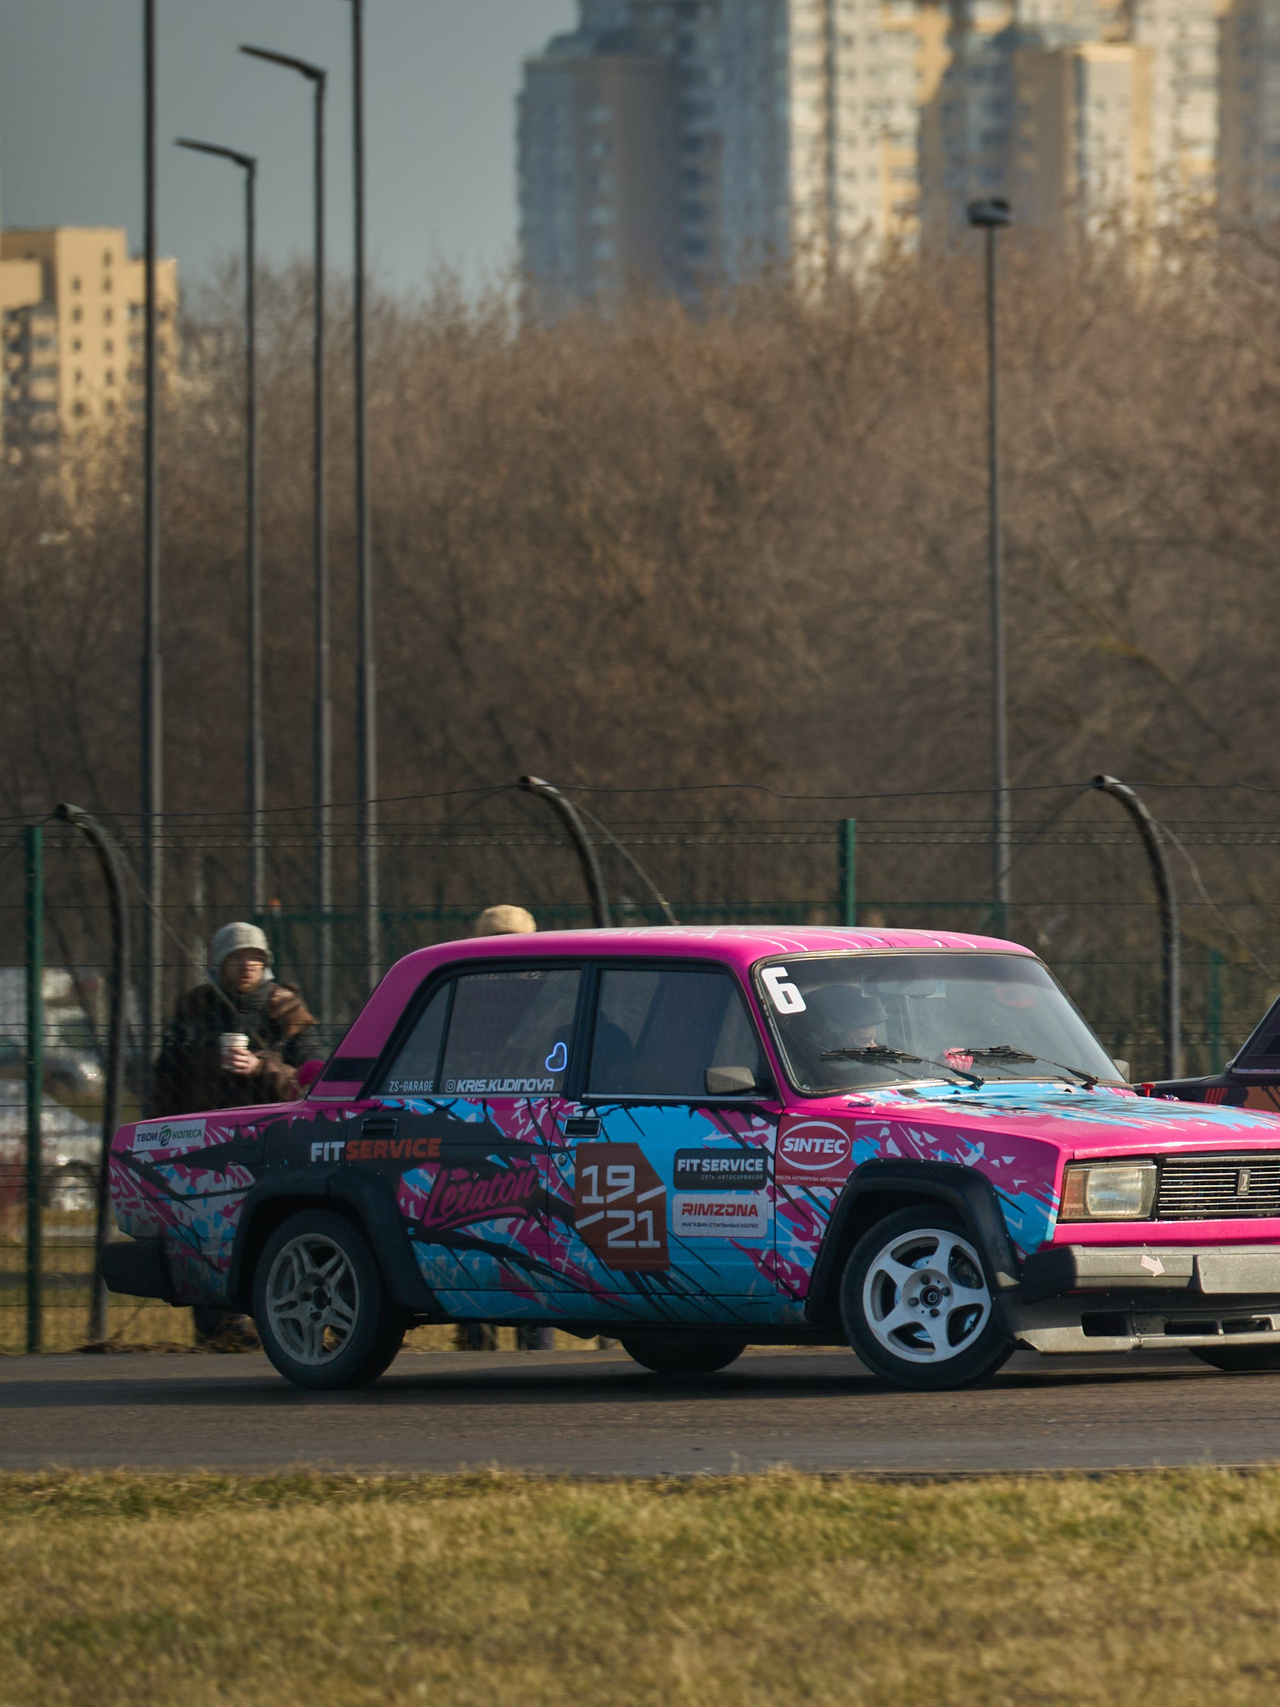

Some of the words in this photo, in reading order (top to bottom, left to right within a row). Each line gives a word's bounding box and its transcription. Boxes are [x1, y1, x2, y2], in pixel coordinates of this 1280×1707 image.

[761, 966, 807, 1015] 6
[389, 1080, 434, 1092] ZS-GARAGE
[456, 1078, 555, 1093] KRIS.KUDINOVA
[172, 1129, 203, 1140] КОЛЕСА
[782, 1137, 847, 1154] SINTEC
[681, 1202, 759, 1217] RIMZONA
